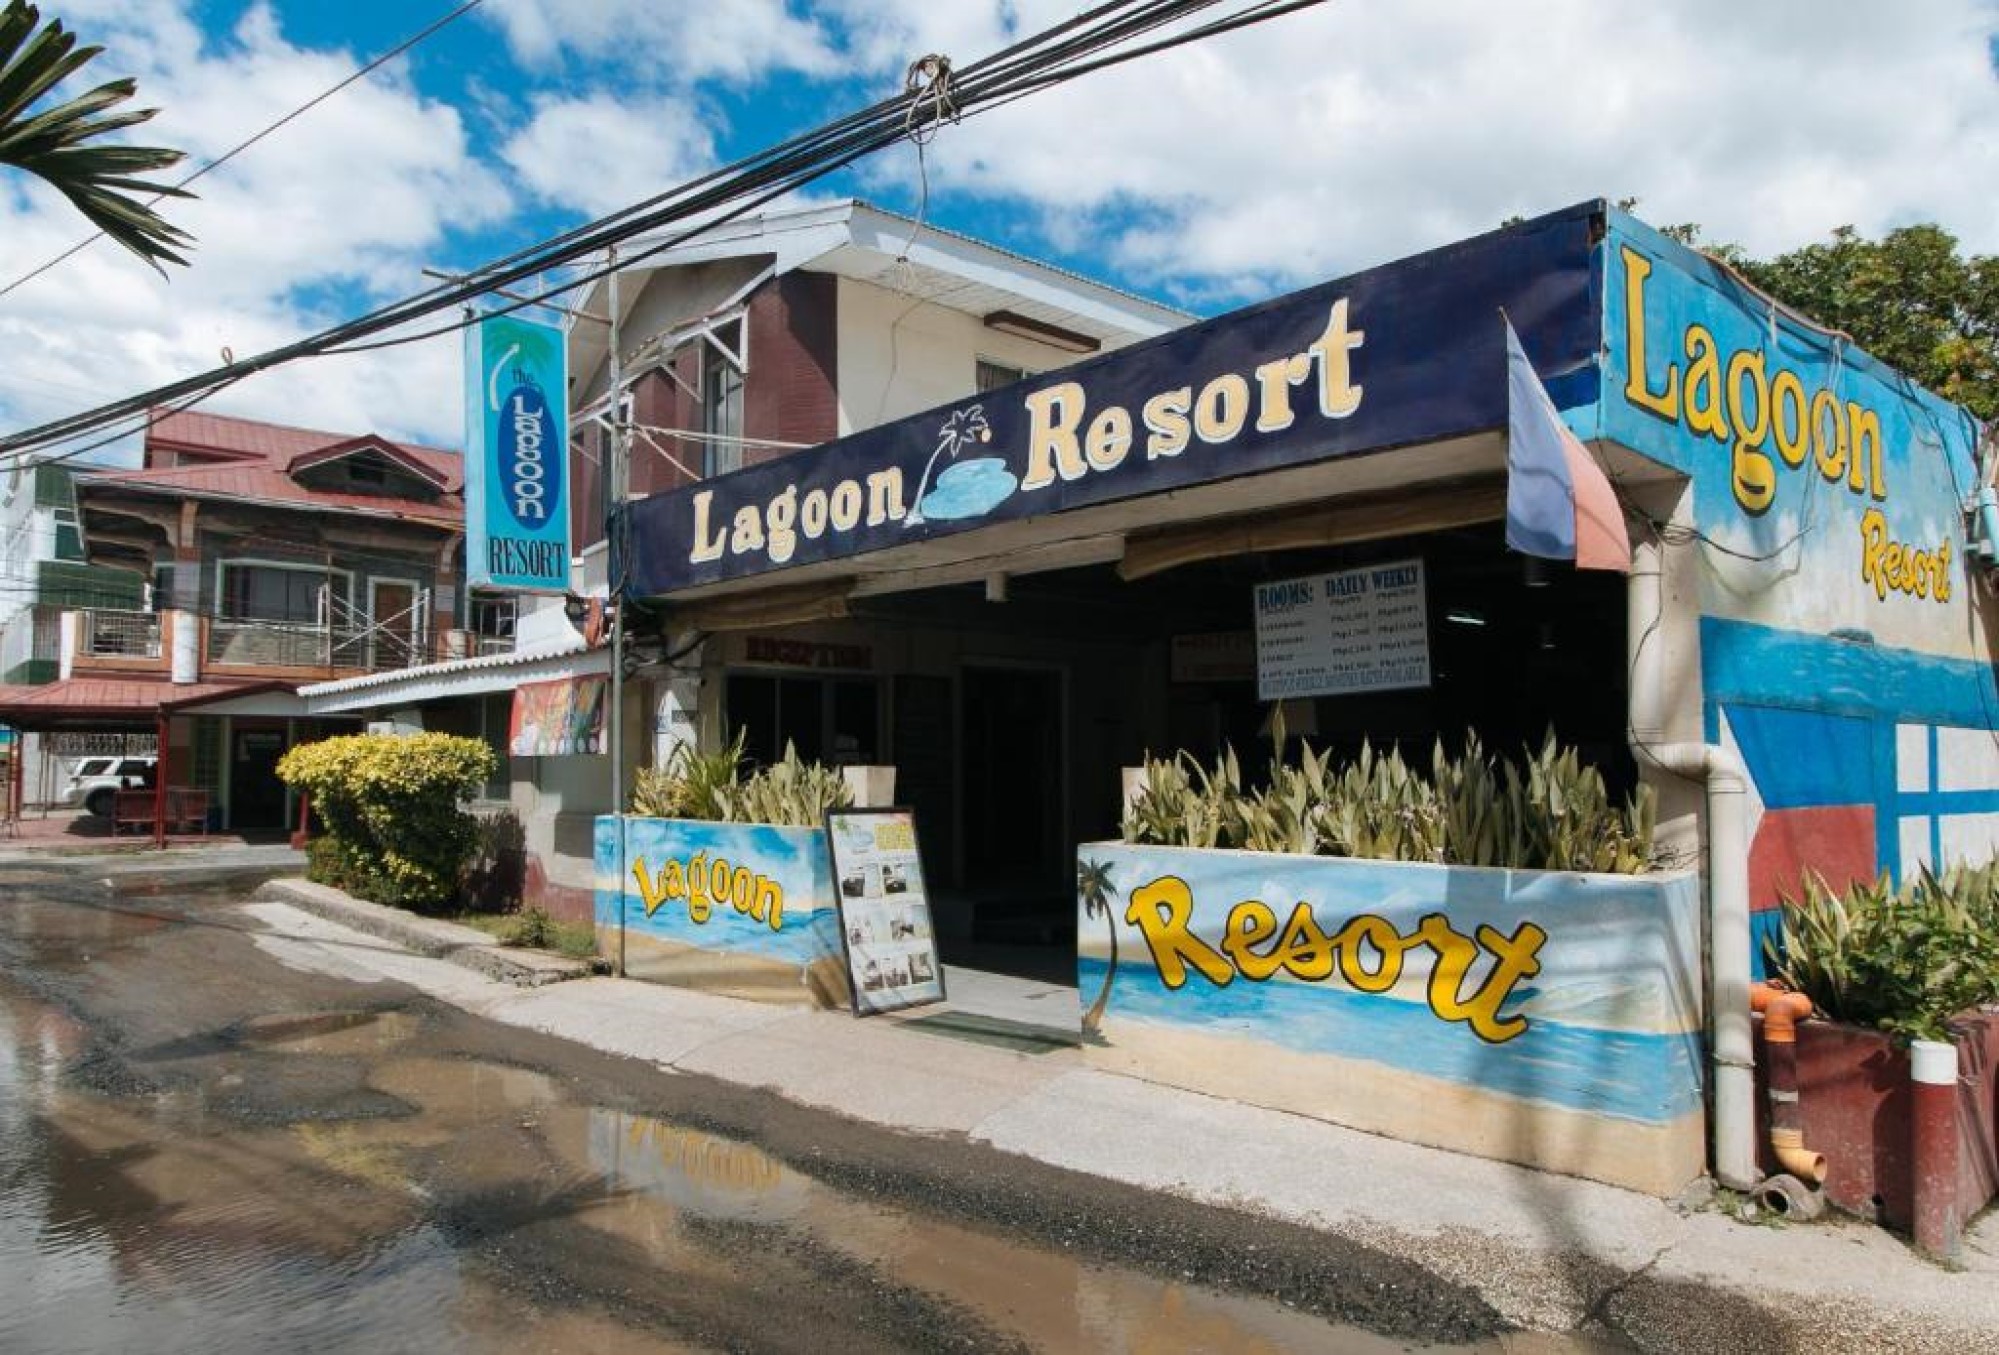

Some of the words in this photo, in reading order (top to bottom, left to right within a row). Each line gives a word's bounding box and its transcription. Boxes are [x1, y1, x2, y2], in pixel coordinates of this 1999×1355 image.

[689, 464, 905, 563] Lagoon
[1020, 297, 1364, 491] Resort
[1620, 245, 1886, 516] Lagoon
[512, 395, 545, 518] Lagoon
[489, 536, 564, 578] RESORT
[1861, 507, 1952, 603] Resort
[632, 849, 783, 932] Lagoon
[1125, 875, 1547, 1043] Resort
